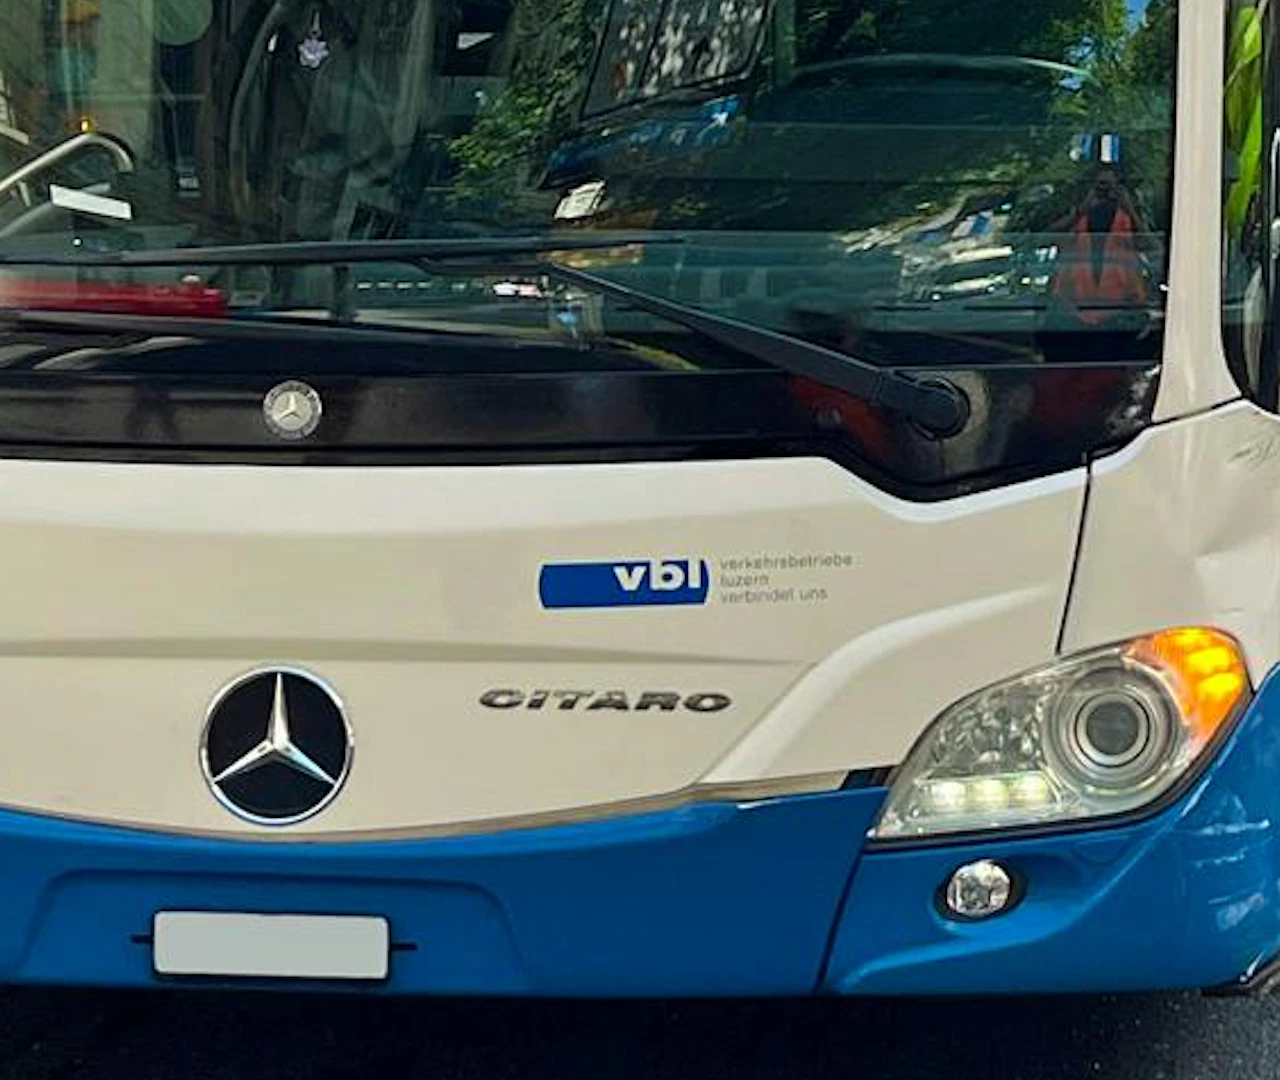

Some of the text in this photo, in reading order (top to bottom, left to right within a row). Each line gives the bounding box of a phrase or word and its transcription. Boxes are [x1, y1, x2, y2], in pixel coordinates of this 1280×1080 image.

[612, 552, 854, 592] vbl verkehrsbetriebe
[799, 588, 828, 602] uns
[479, 689, 732, 713] CITARO
